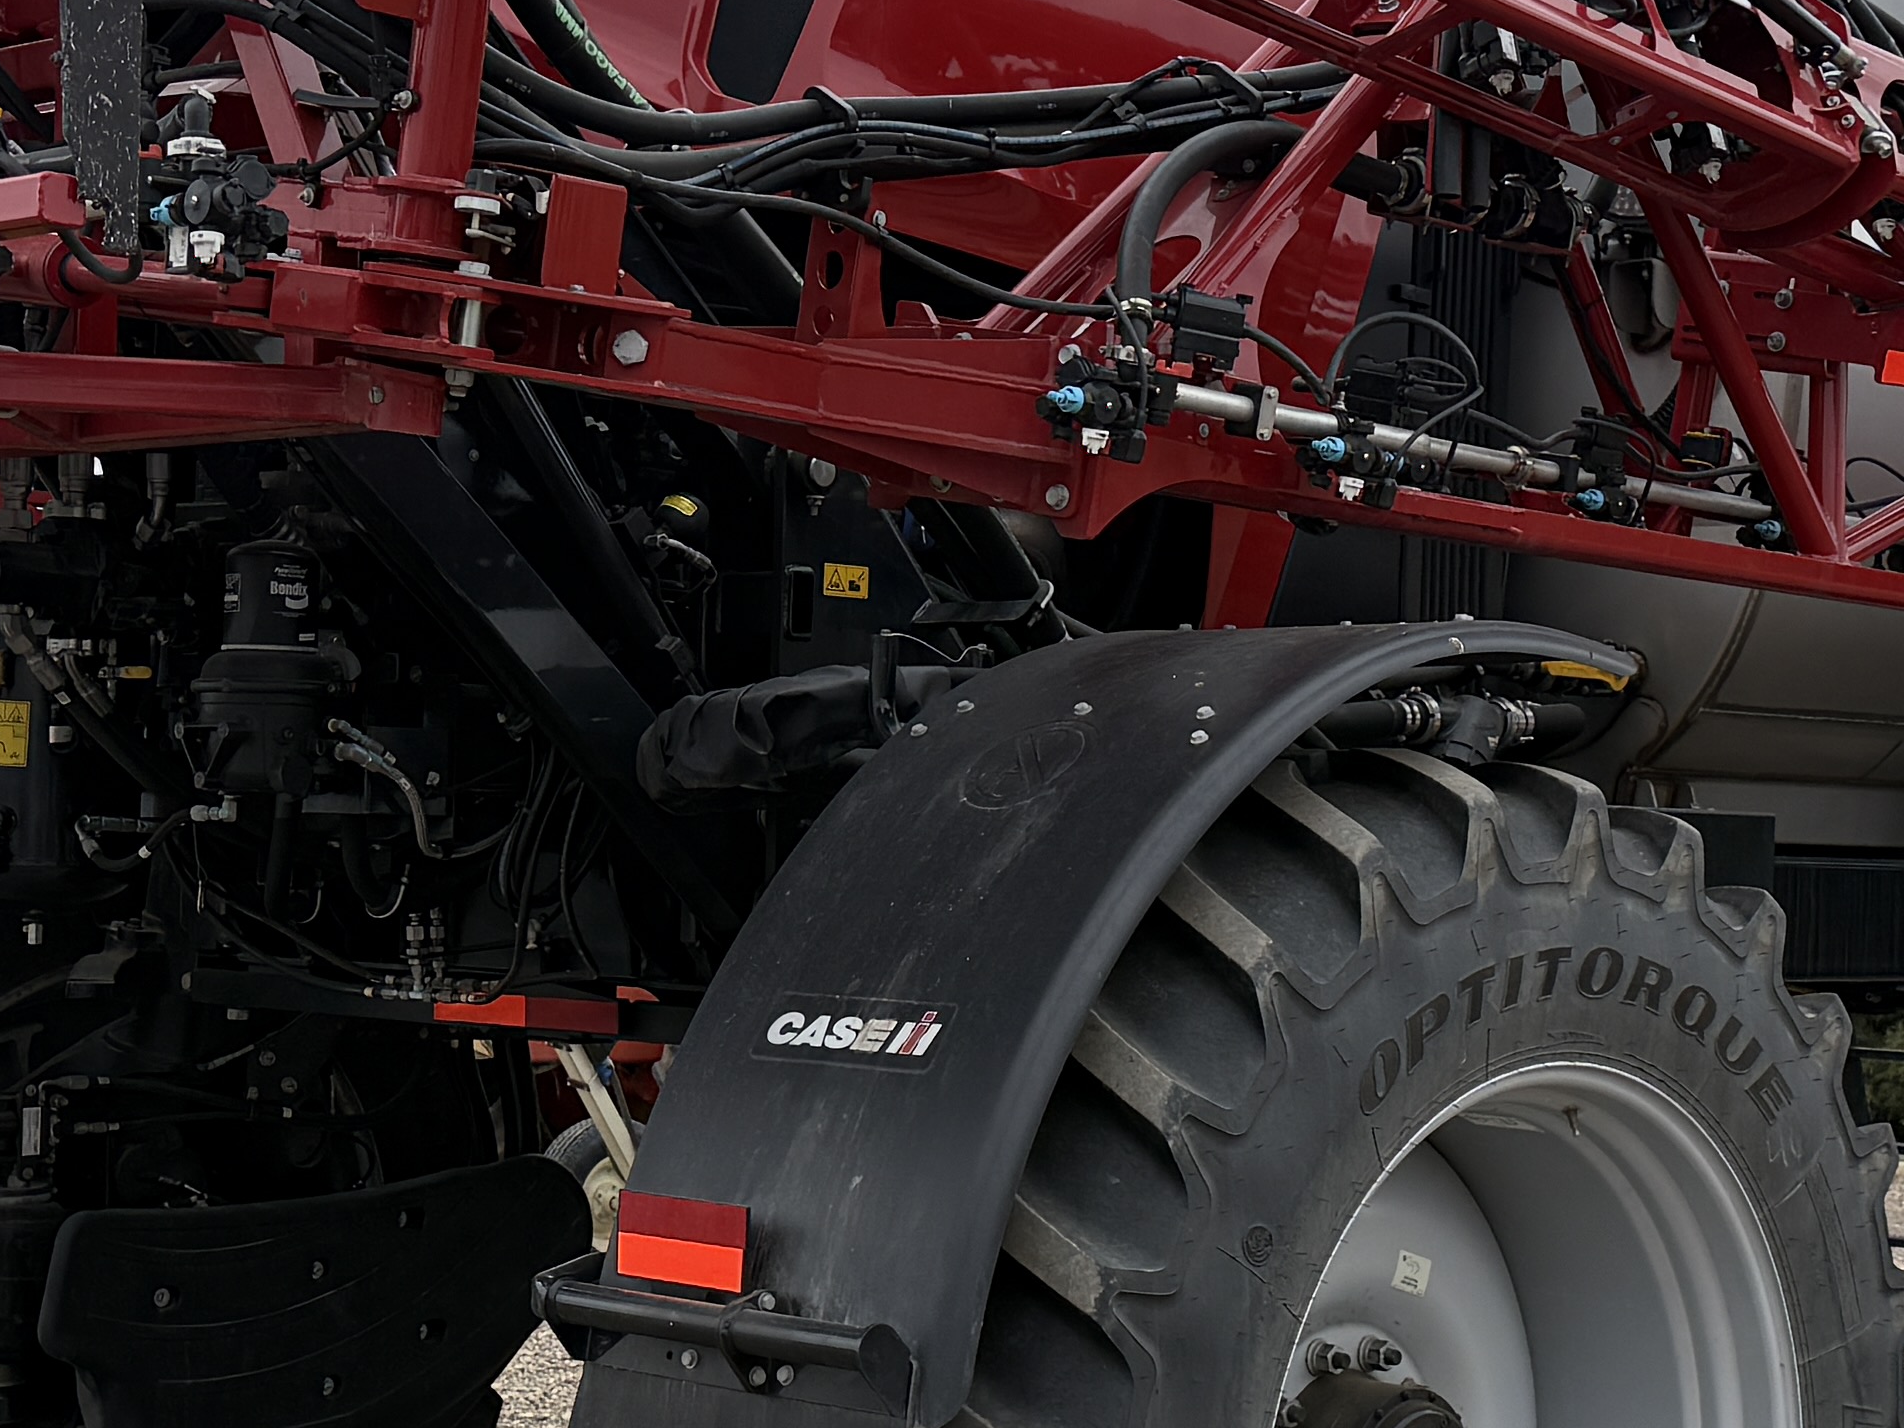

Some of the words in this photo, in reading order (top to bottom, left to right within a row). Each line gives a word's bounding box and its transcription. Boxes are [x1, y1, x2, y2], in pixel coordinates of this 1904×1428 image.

[270, 580, 308, 597] Bendix
[766, 1011, 898, 1053] CASE
[1358, 945, 1796, 1126] OPTITORQUE
